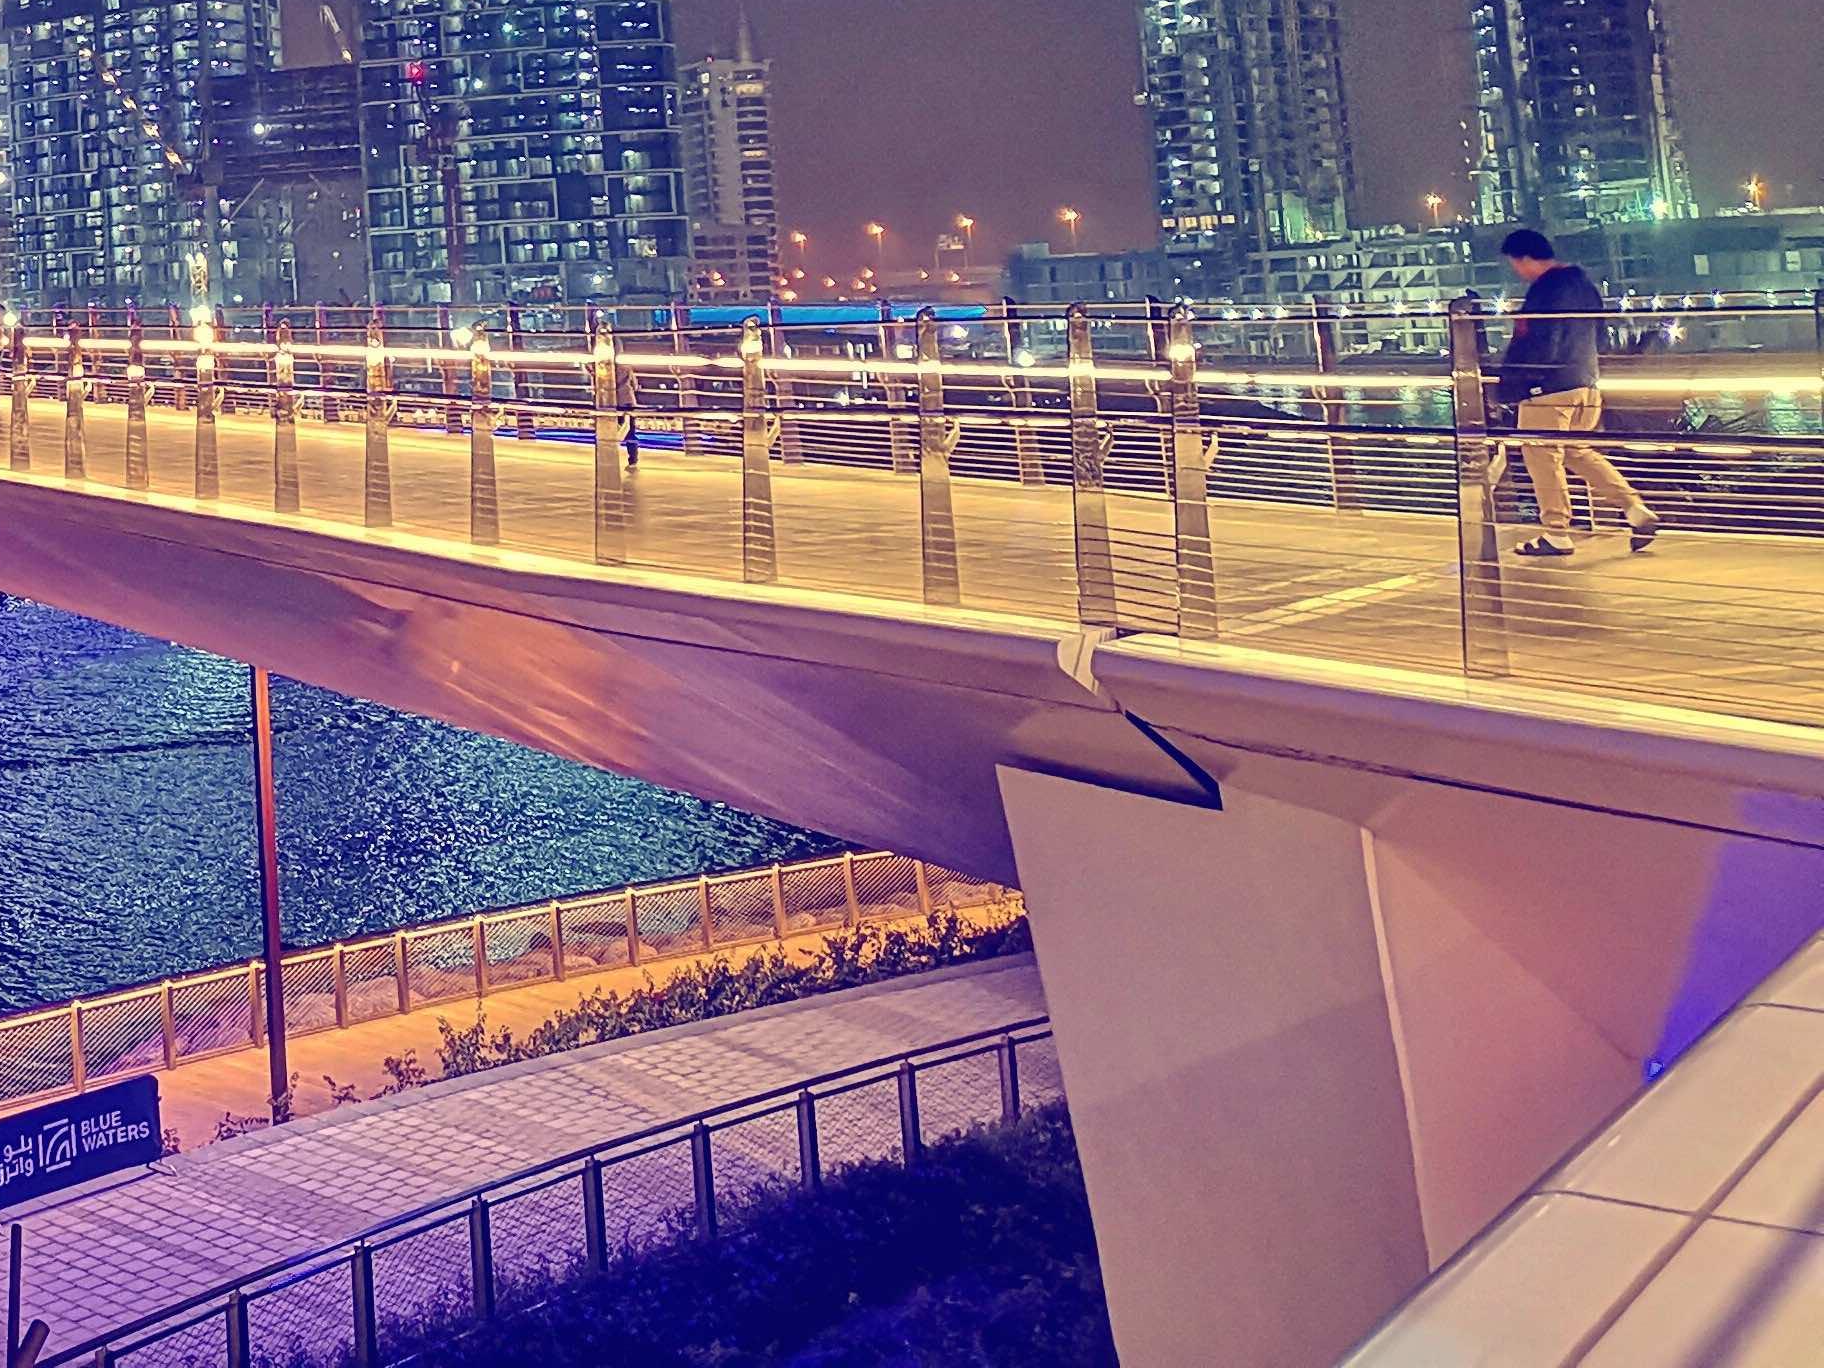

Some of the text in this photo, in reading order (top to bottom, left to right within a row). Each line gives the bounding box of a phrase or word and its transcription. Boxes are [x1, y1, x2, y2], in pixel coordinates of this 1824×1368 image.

[81, 1110, 122, 1137] BLUE
[82, 1121, 150, 1153] WATERS
[3, 1134, 33, 1163] بلو
